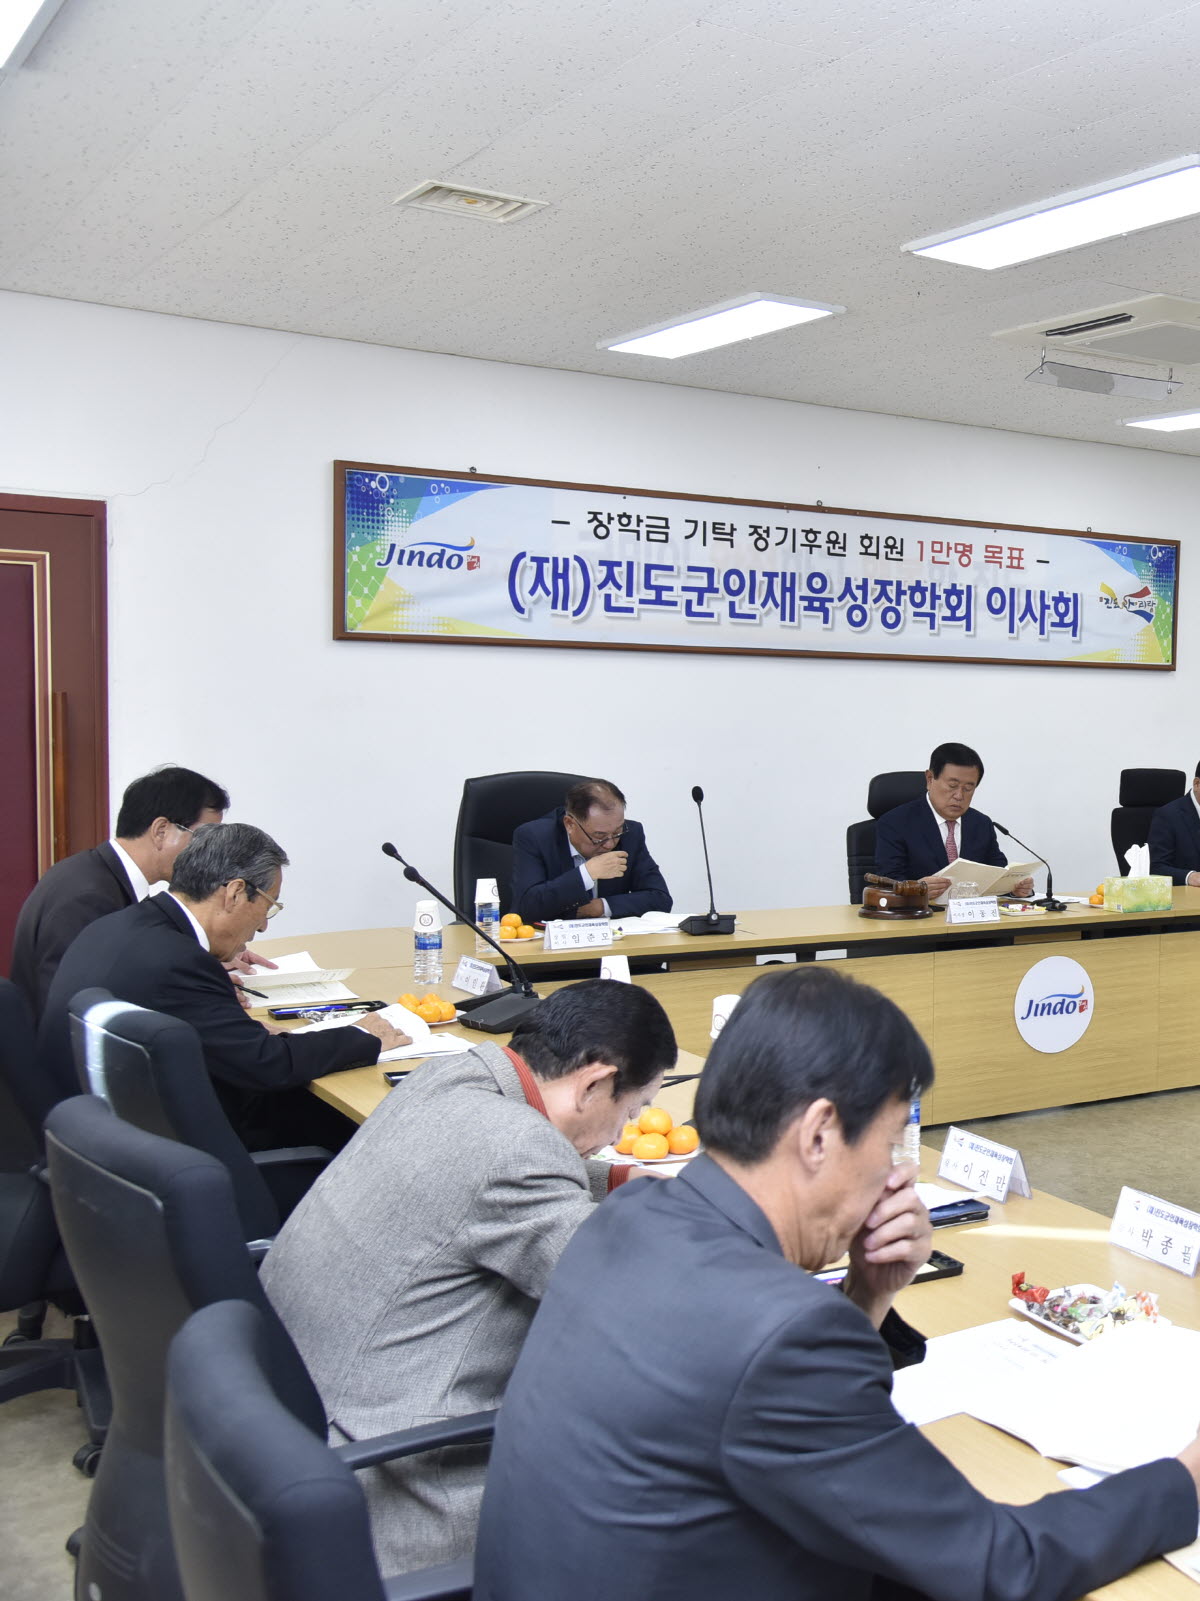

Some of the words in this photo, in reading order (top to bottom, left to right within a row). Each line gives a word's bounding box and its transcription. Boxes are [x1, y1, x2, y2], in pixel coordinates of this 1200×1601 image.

[377, 543, 464, 570] Jindo
[587, 511, 670, 543] 장학금
[684, 518, 737, 548] 기탁
[748, 523, 847, 557] 정기후원
[859, 533, 904, 562] 회원
[916, 540, 974, 568] 1만명
[983, 544, 1025, 570] 목표
[507, 551, 973, 632] (재)진도군인재육성장학회
[986, 586, 1079, 637] 이사회
[1021, 998, 1077, 1020] Jindo
